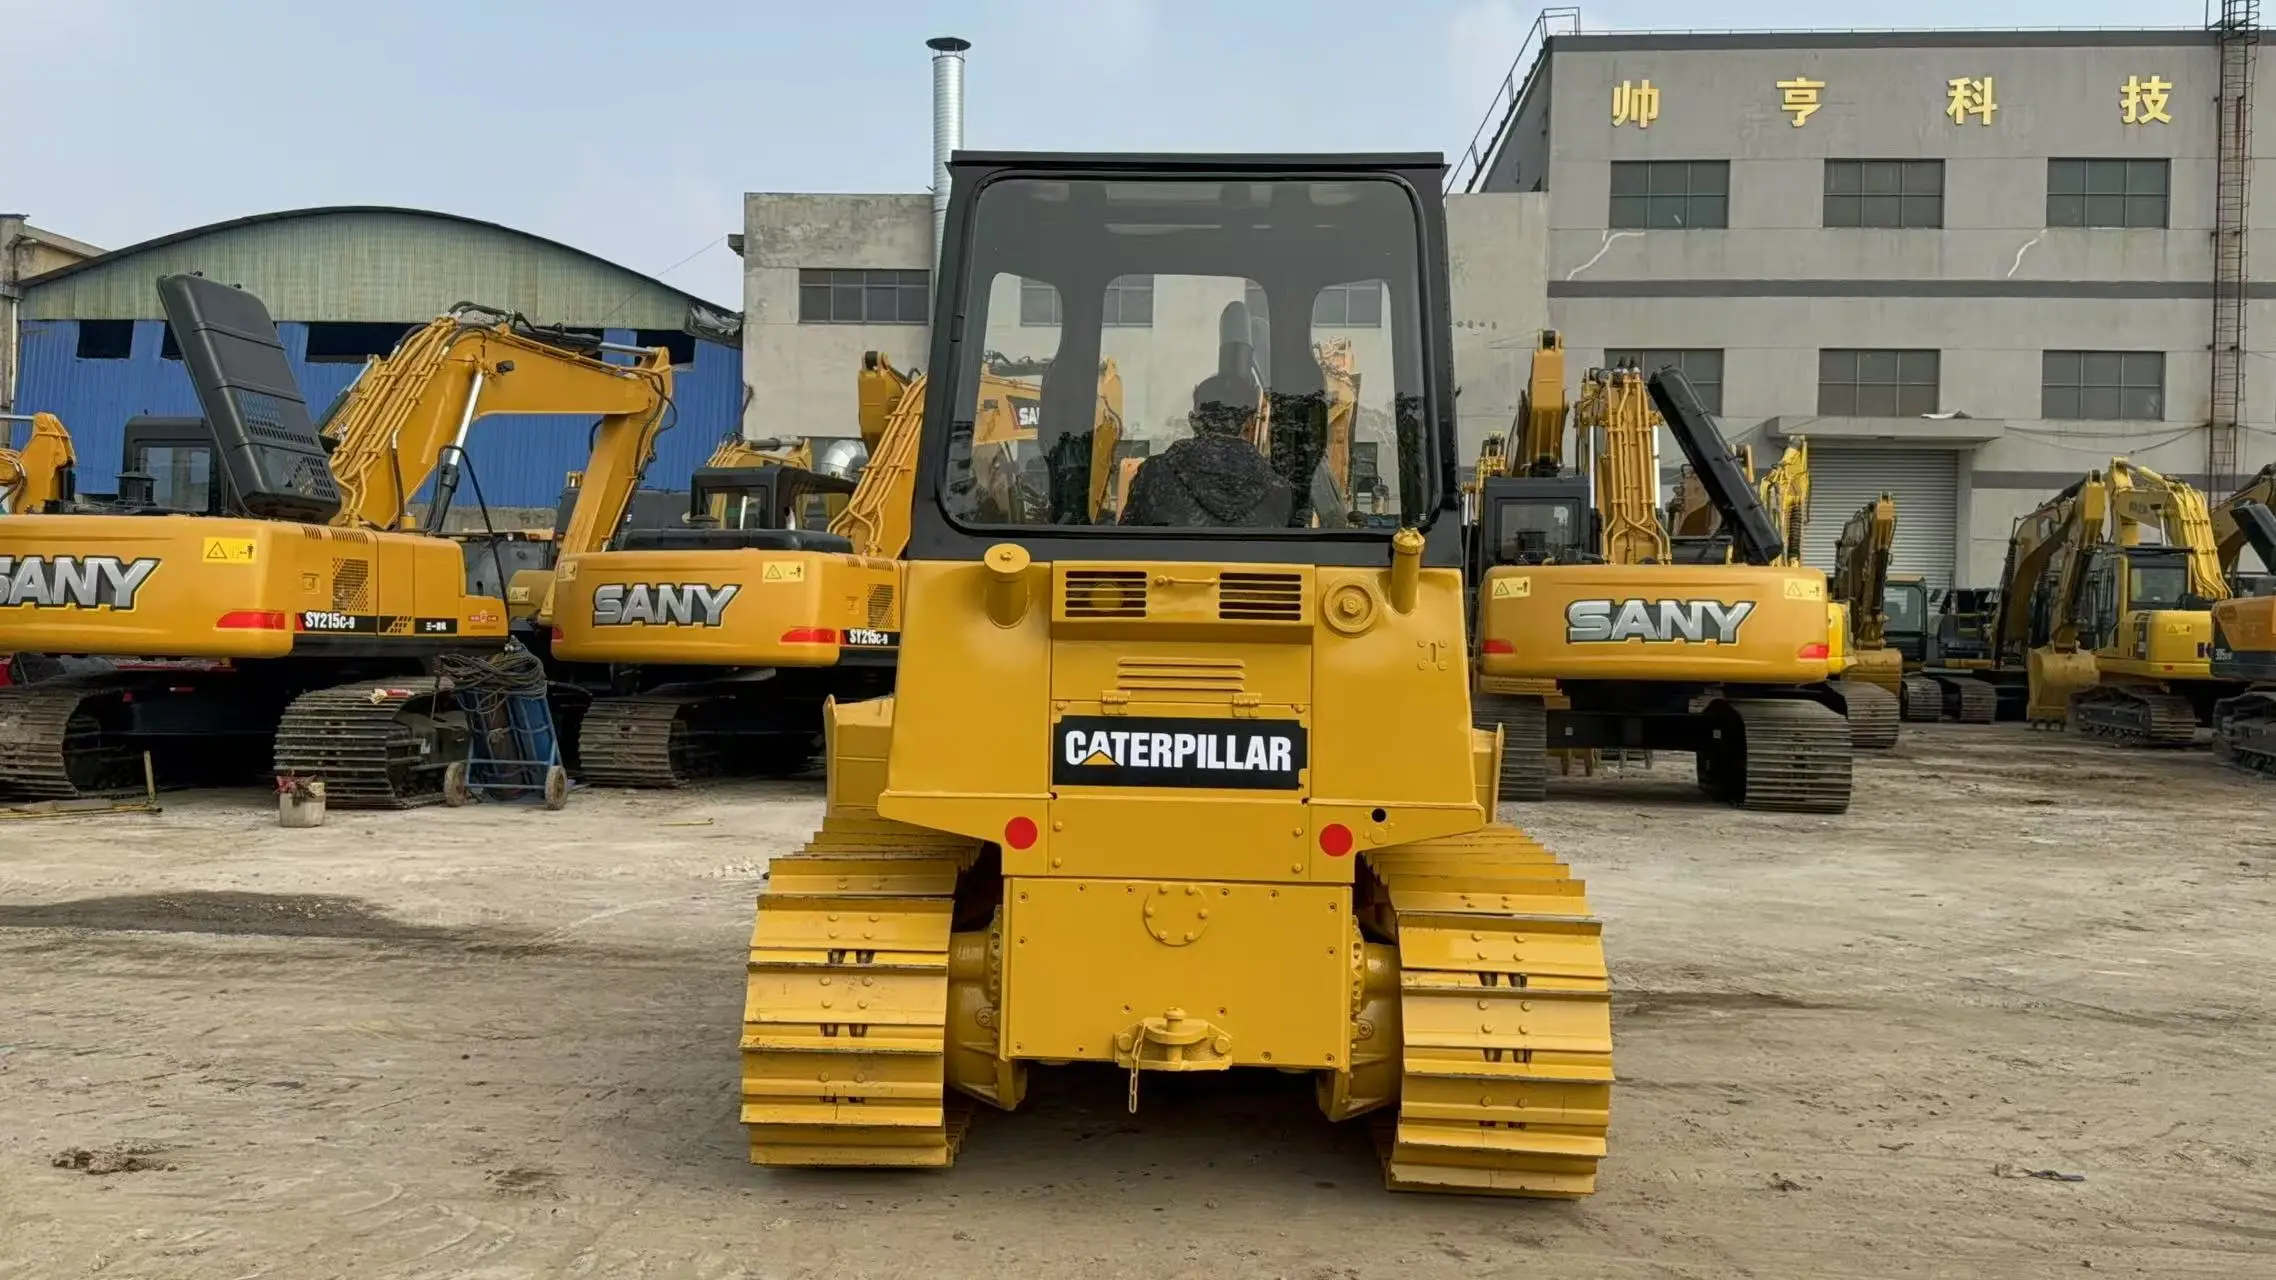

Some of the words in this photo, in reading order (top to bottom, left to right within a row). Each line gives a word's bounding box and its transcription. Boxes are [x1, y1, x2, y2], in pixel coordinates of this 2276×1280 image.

[1611, 75, 2173, 129] 帅亨科技
[1019, 407, 1040, 425] SA
[593, 583, 742, 627] SANY
[1565, 599, 1756, 645] SANY
[1065, 730, 1291, 771] CATERPILLAR
